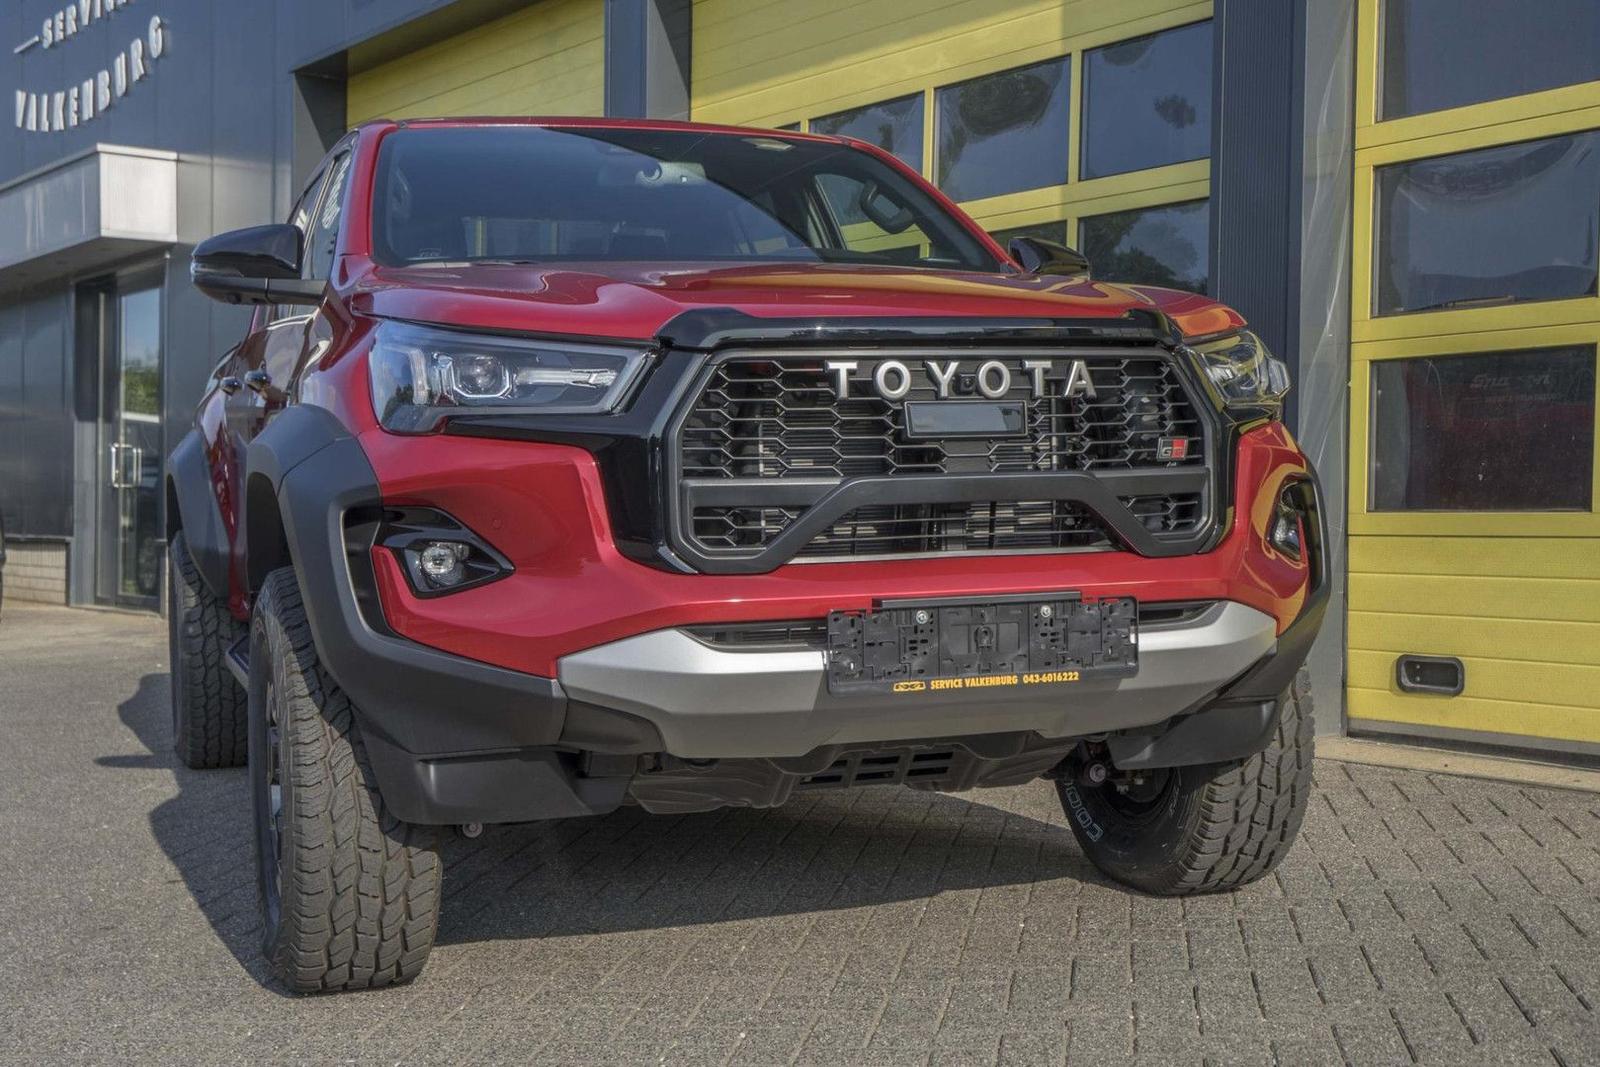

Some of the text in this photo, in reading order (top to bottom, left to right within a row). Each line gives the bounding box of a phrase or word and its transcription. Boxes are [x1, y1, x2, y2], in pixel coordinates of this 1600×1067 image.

[42, 0, 127, 49] SERVI
[16, 15, 163, 132] VALKENBURG
[825, 360, 1098, 401] TOYOTA
[930, 671, 1080, 690] SERVICE VALKENBURG 043-6016222
